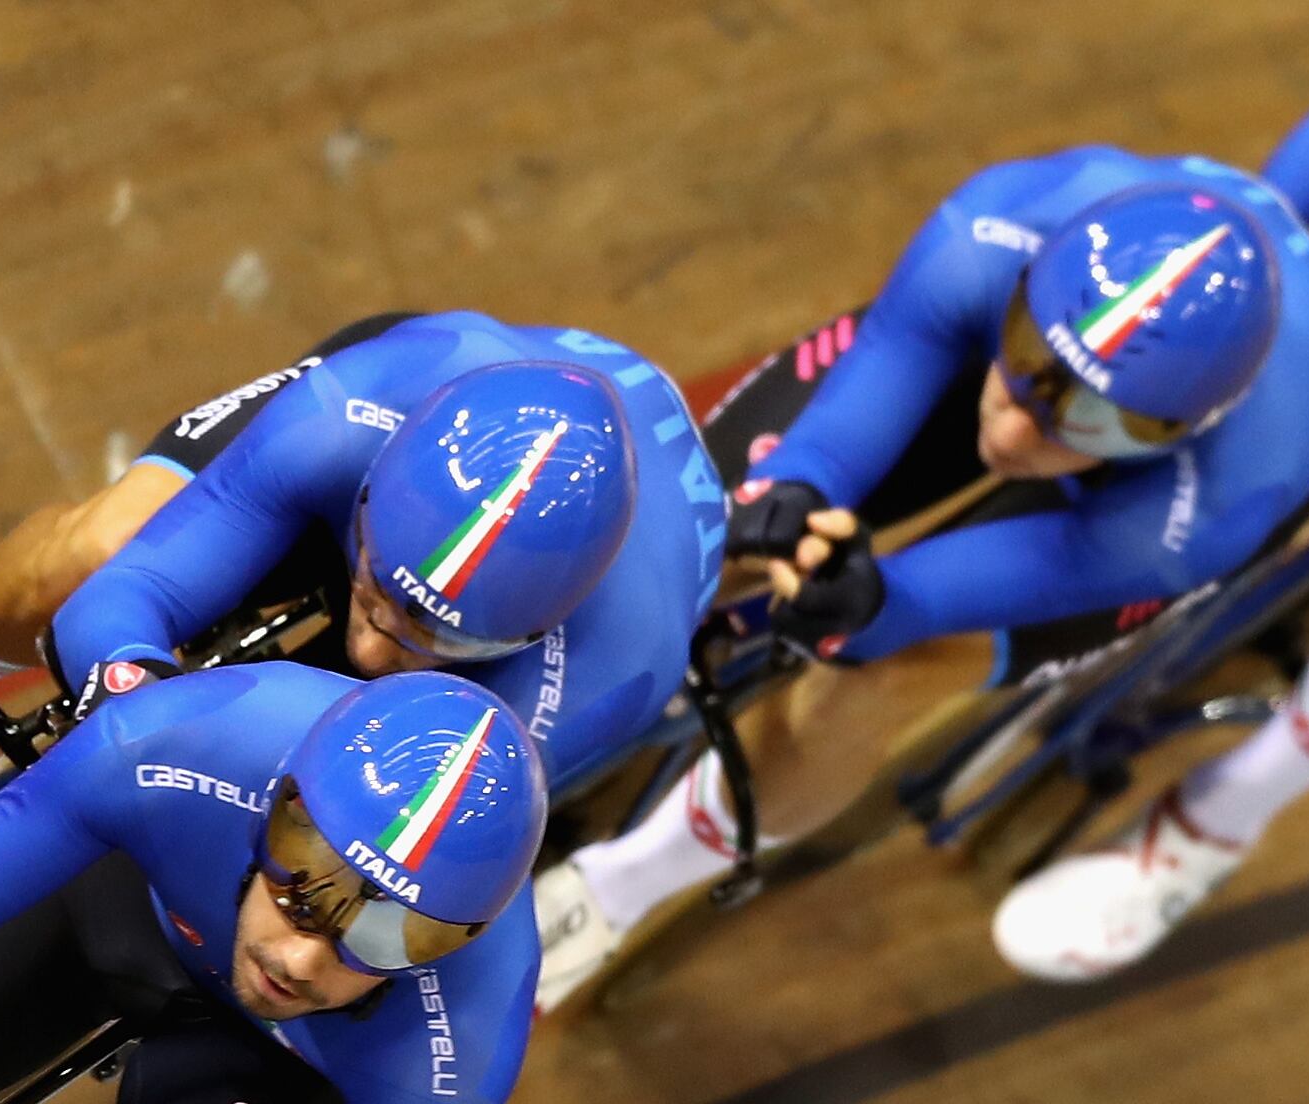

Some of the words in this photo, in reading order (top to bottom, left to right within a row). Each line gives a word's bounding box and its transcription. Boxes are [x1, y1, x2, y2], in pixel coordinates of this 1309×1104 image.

[393, 566, 462, 627] ITALIA
[528, 625, 566, 741] ASTELLI
[345, 840, 421, 904] ITALIA
